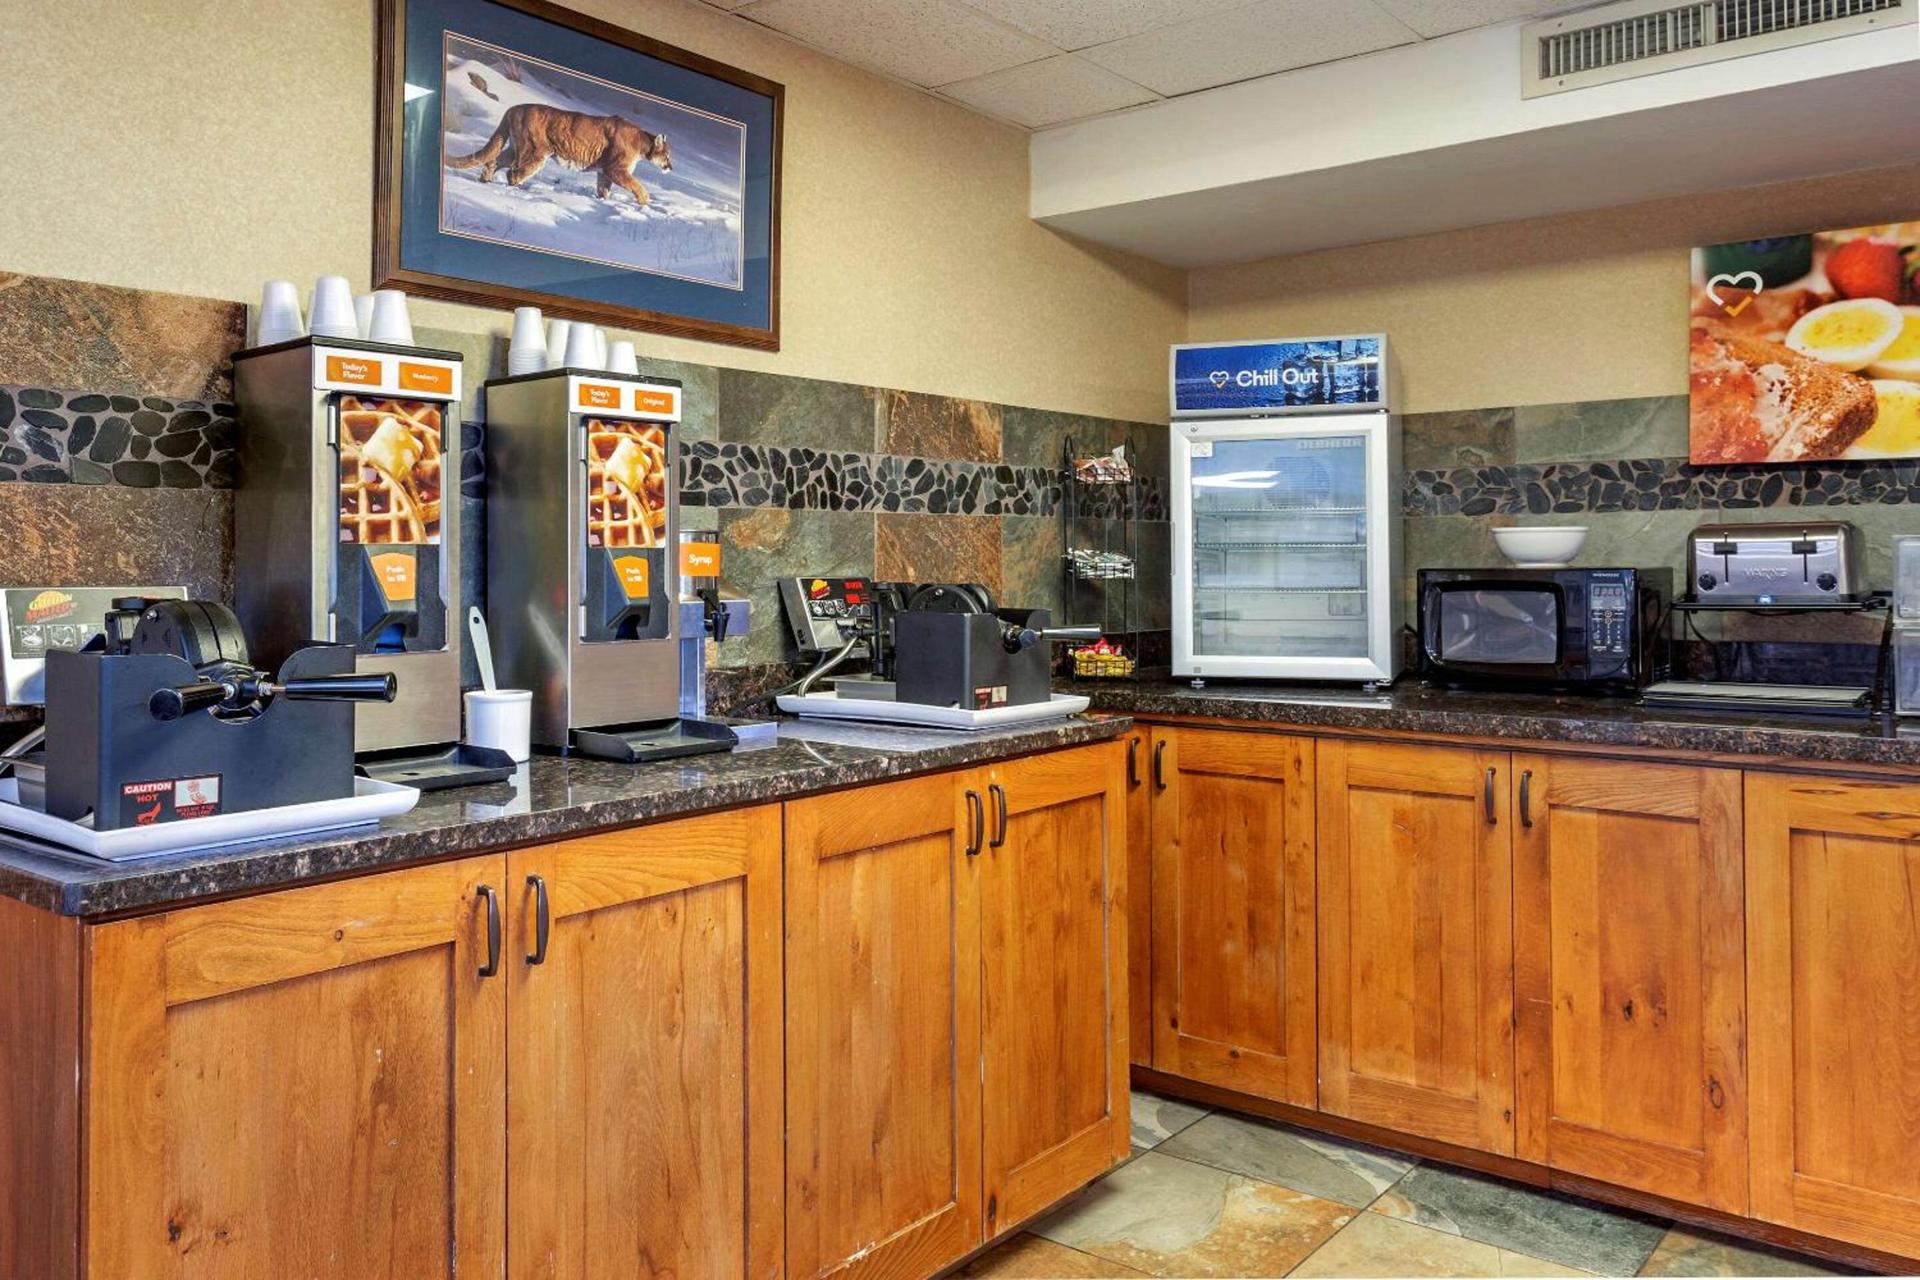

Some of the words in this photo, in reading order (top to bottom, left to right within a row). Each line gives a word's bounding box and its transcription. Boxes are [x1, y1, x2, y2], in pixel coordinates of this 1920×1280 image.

[341, 361, 368, 374] Today's
[342, 370, 366, 380] Flavor
[1236, 368, 1278, 388] Chill
[1282, 367, 1319, 385] Out
[643, 397, 665, 407] Original
[688, 553, 713, 567] Syrup
[124, 781, 173, 795] CAUTION
[136, 792, 160, 803] HOT
